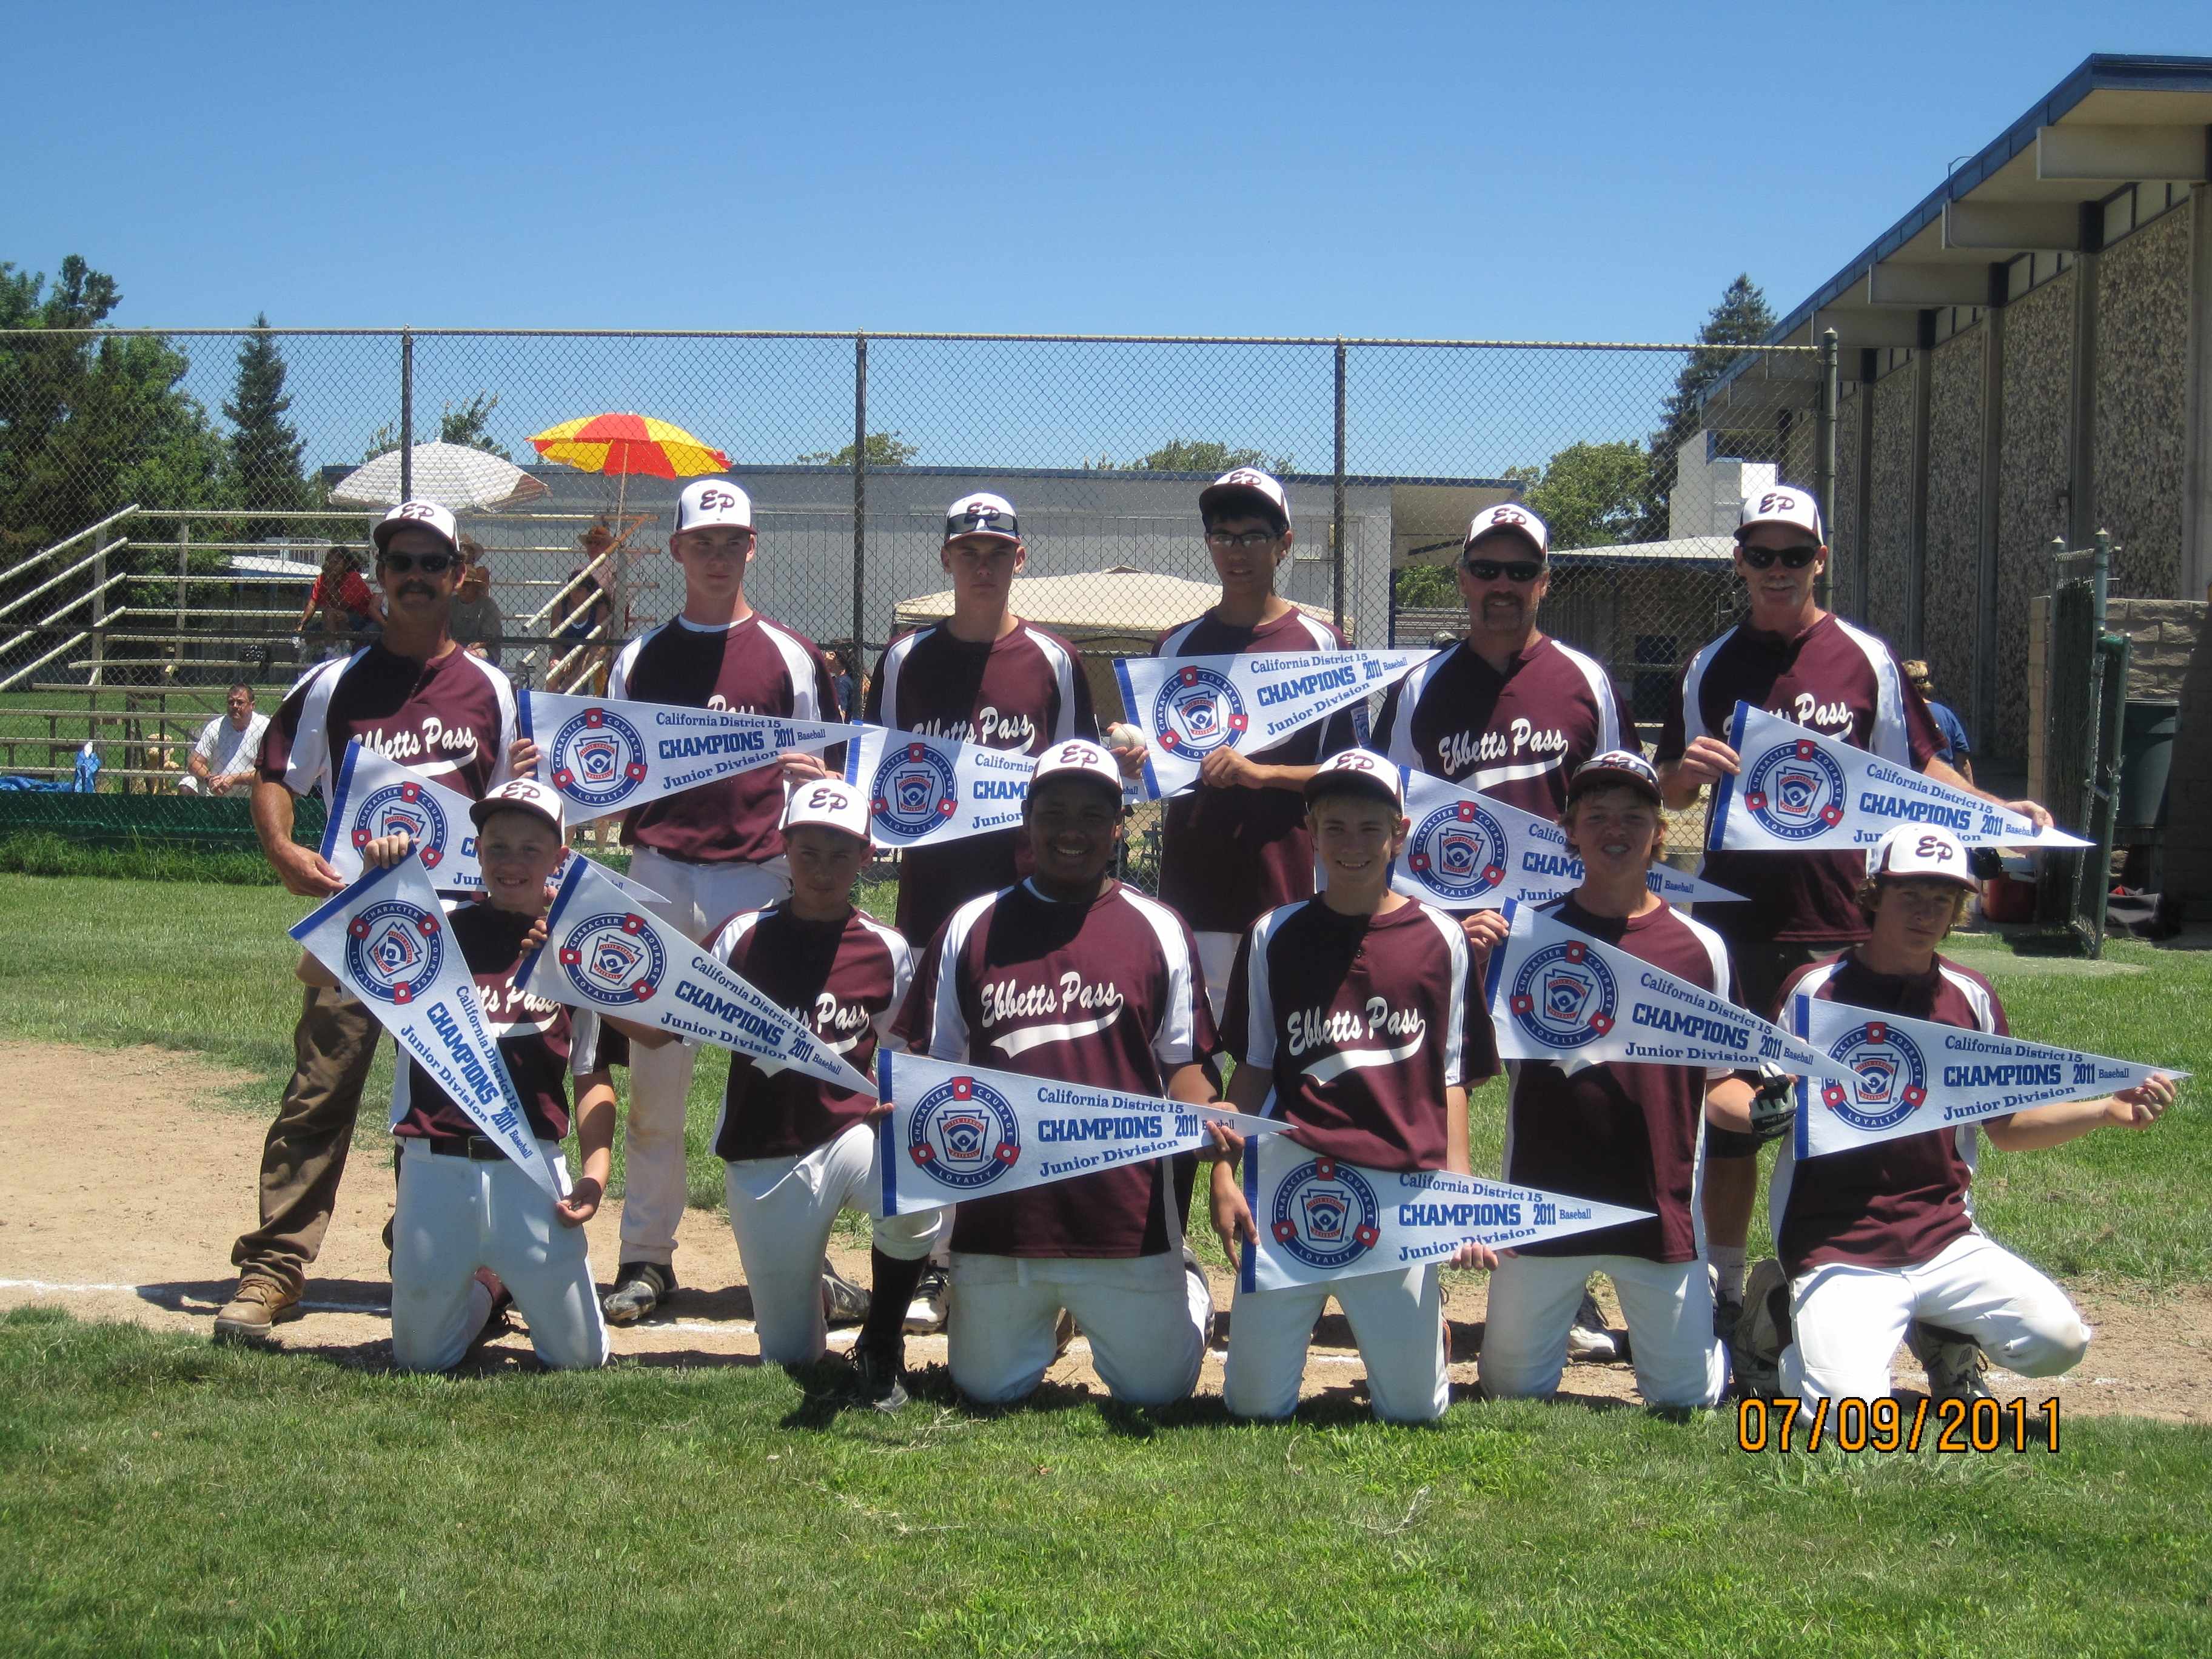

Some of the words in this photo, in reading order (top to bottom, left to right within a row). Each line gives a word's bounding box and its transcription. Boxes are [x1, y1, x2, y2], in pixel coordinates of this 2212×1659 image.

[400, 503, 435, 520] EP
[699, 489, 735, 513] EP
[1758, 493, 1795, 514] EP
[1251, 656, 1310, 674] California
[1311, 655, 1353, 666] District
[1355, 653, 1368, 662] 15
[1257, 666, 1356, 706] CHAMPIONS
[1363, 659, 1382, 680] 2011
[1382, 657, 1407, 670] Baseball
[1158, 680, 1179, 730] CHARACTER
[1202, 674, 1239, 708] COURAGE
[1267, 708, 1313, 736] Junior
[1314, 682, 1370, 712] Division
[1795, 693, 1851, 728] Pass
[422, 717, 476, 753] Pass
[608, 717, 640, 756] COURAGE
[656, 712, 716, 726] California
[720, 716, 765, 728] District
[767, 719, 781, 728] 15
[980, 706, 1033, 744] Pass
[555, 720, 582, 768] CHARACTER
[659, 731, 765, 759] CHAMPIONS
[774, 728, 796, 748] 2011
[797, 729, 826, 741] Baseball
[975, 753, 1034, 773] California
[1060, 745, 1099, 768] EP
[1438, 730, 1508, 776] Ebbetts
[1510, 718, 1567, 756] Pass
[663, 766, 713, 789] Junior
[714, 749, 779, 774] Division
[873, 754, 905, 796] CHARACTER
[928, 753, 954, 794] COURAGE
[1752, 748, 1791, 789] CHARACTER
[1818, 754, 1841, 802] COURAGE
[360, 789, 398, 826] CHARACTER
[501, 782, 540, 800] EP
[578, 788, 624, 802] LOYALTY
[809, 788, 848, 813] EP
[1866, 763, 1928, 793] California
[1929, 786, 1978, 810] District
[1979, 803, 1994, 814] 15
[421, 797, 443, 844] COURAGE
[888, 821, 934, 832] LOYALTY
[1416, 809, 1453, 850] CHARACTER
[1766, 819, 1814, 835] LOYALTY
[1859, 792, 1971, 830] CHAMPIONS
[1980, 814, 2003, 836] 2011
[1479, 815, 1502, 860] COURAGE
[1915, 835, 1953, 863] EP
[1430, 880, 1475, 896] LOYALTY
[1665, 880, 1694, 894] Baseball
[366, 906, 418, 920] CHARACTER
[570, 919, 619, 947] CHARACTER
[351, 951, 382, 993] LOYALTY
[416, 939, 438, 989] COURAGE
[644, 931, 660, 979] COURAGE
[1519, 950, 1561, 992] CHARACTER
[575, 976, 622, 1000] LOYALTY
[691, 956, 749, 1000] California
[749, 995, 793, 1030] District
[793, 1025, 808, 1039] 15
[980, 979, 1057, 1028] Ebbetts
[1059, 971, 1121, 1014] Pass
[1589, 957, 1613, 1009] COURAGE
[815, 992, 870, 1034] Pass
[1640, 973, 1705, 1008] California
[1707, 1000, 1756, 1028] District
[1757, 1024, 1773, 1034] 15
[660, 1012, 717, 1037] Junior
[718, 1030, 788, 1061] Division
[674, 980, 785, 1047] CHAMPIONS
[788, 1038, 814, 1063] 2011
[813, 1053, 842, 1075] Baseball
[1287, 1005, 1362, 1056] Ebbetts
[1366, 996, 1423, 1040] Pass
[1532, 1025, 1581, 1043] LOYALTY
[1632, 1002, 1749, 1051] CHAMPIONS
[1758, 1034, 1782, 1061] 2011
[1783, 1047, 1814, 1065] Baseball
[456, 985, 489, 1049] California
[484, 1047, 511, 1096] District
[506, 1095, 519, 1111] 15
[1625, 1042, 1683, 1058] Junior
[1687, 1047, 1759, 1063] Division
[1889, 1034, 1921, 1079] COURAGE
[1945, 1035, 2011, 1055] California
[2015, 1045, 2065, 1061] District
[2068, 1053, 2083, 1062] 15
[400, 1024, 441, 1070] Junior
[438, 1067, 488, 1122] Division
[426, 1002, 500, 1105] CHAMPIONS
[491, 1106, 518, 1134] 2011
[509, 1129, 533, 1159] Baseball
[1943, 1064, 2061, 1087] CHAMPIONS
[2073, 1064, 2096, 1084] 2011
[2098, 1068, 2129, 1079] Baseball
[915, 1090, 948, 1141] CHARACTER
[977, 1089, 1013, 1137] COURAGE
[1037, 1087, 1108, 1108] California
[1111, 1096, 1165, 1113] District
[1168, 1104, 1184, 1114] 15
[1848, 1113, 1898, 1125] LOYALTY
[1943, 1099, 2000, 1121] Junior
[2003, 1087, 2076, 1108] Division
[1037, 1115, 1162, 1142] CHAMPIONS
[1175, 1114, 1199, 1138] 2011
[939, 1171, 991, 1183] LOYALTY
[1039, 1155, 1099, 1178] Junior
[1102, 1138, 1179, 1164] Division
[1278, 1168, 1312, 1218] CHARACTER
[1340, 1171, 1373, 1219] COURAGE
[1399, 1173, 1469, 1194] California
[1472, 1183, 1524, 1200] District
[1527, 1191, 1543, 1202] 15
[1399, 1204, 1521, 1226] CHAMPIONS
[1533, 1203, 1556, 1225] 2011
[1559, 1208, 1592, 1220] Baseball
[1299, 1249, 1350, 1263] LOYALTY
[1399, 1241, 1458, 1262] Junior
